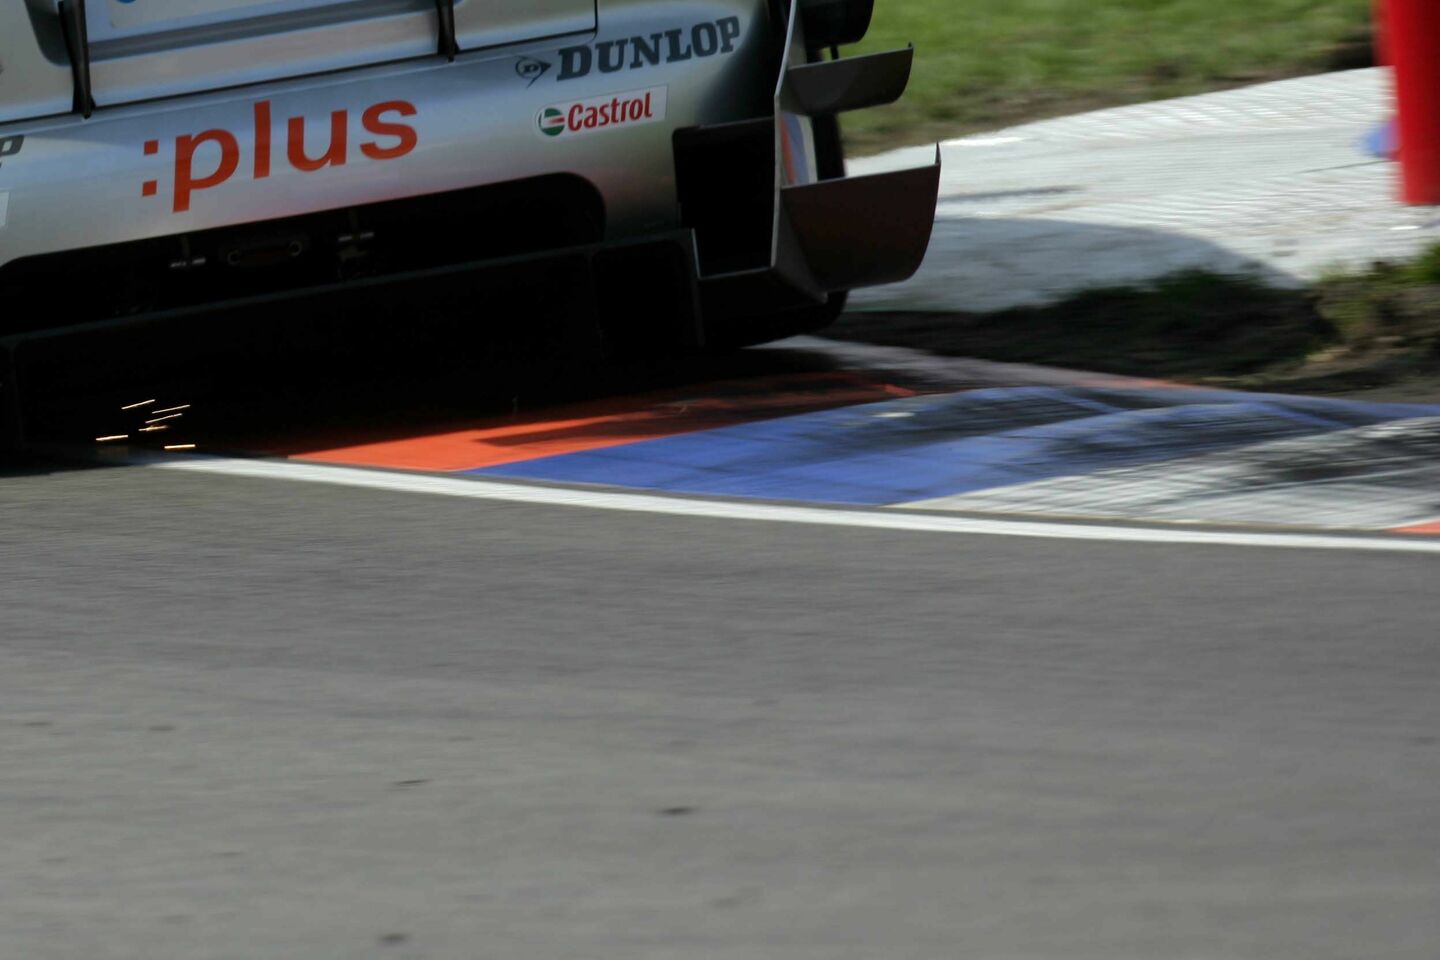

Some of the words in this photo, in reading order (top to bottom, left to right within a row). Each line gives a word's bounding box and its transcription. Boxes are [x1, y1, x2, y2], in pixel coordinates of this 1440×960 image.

[556, 15, 741, 82] DUNLOP
[567, 91, 653, 132] Castrol
[141, 99, 419, 213] :plus
